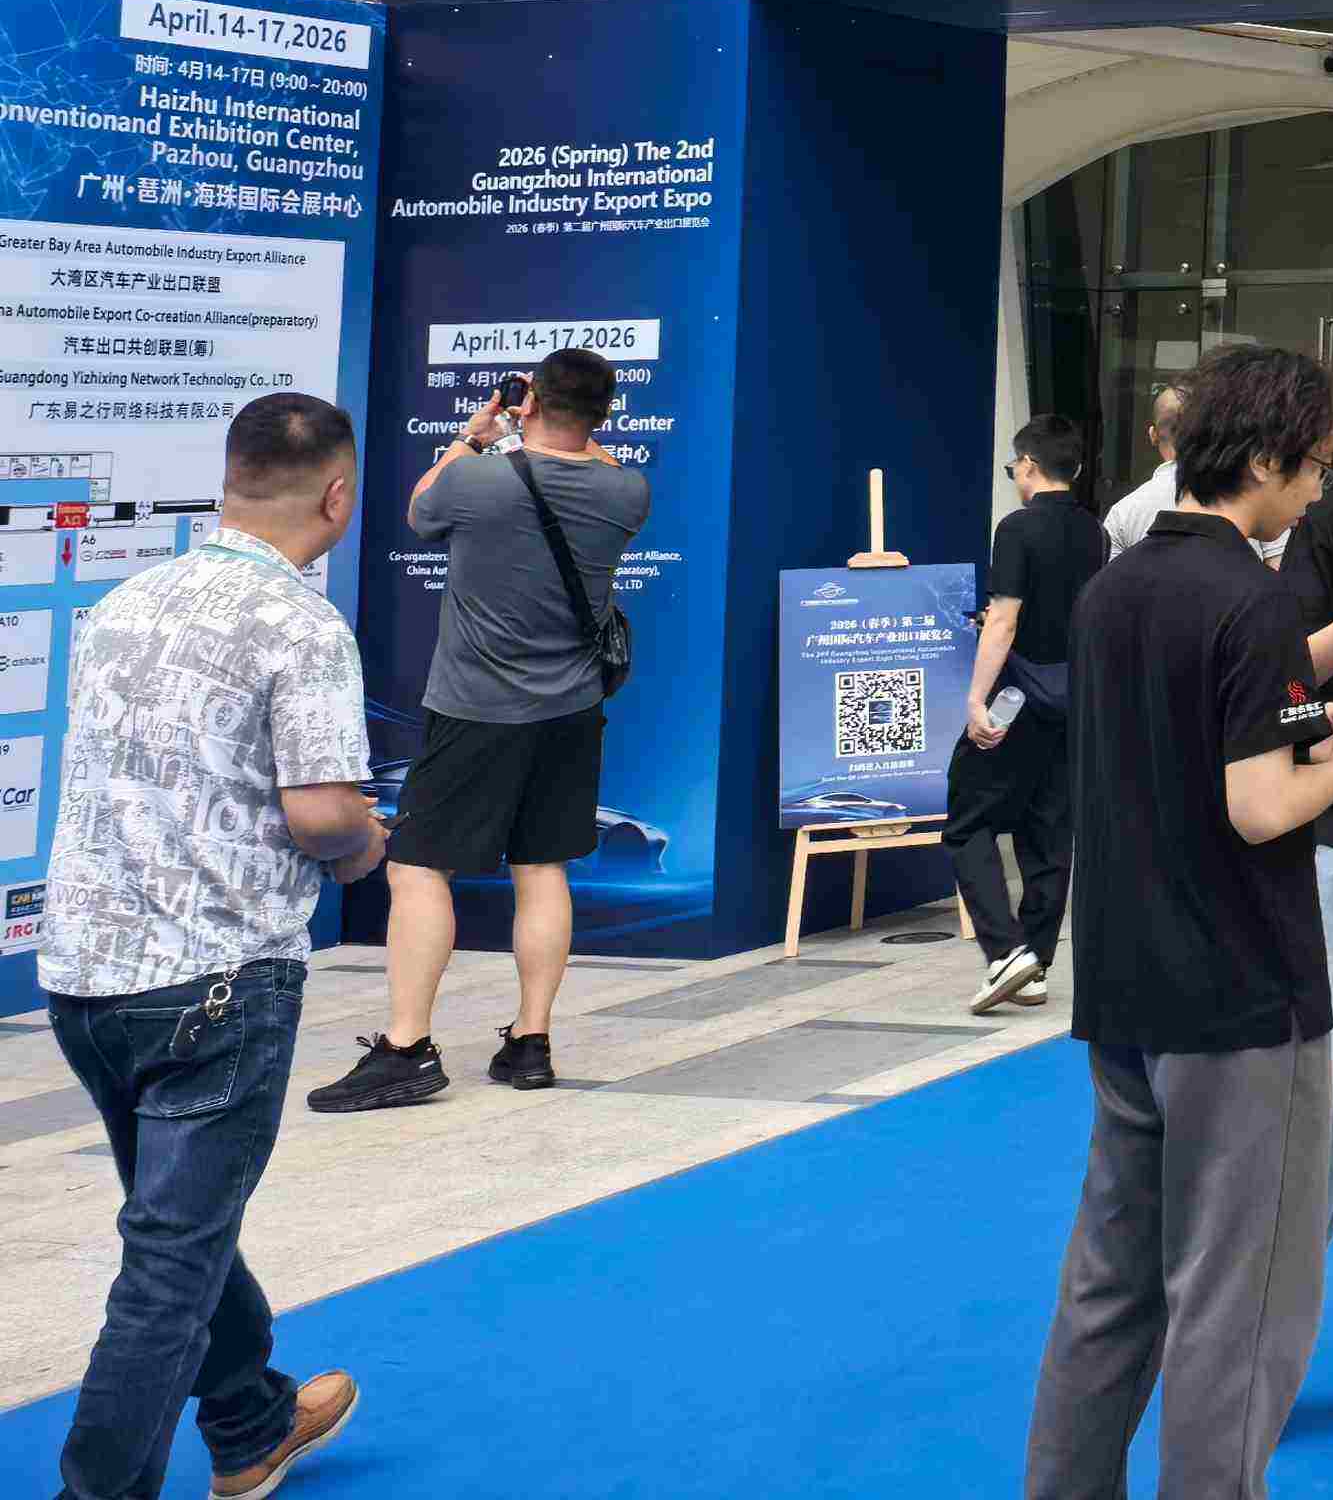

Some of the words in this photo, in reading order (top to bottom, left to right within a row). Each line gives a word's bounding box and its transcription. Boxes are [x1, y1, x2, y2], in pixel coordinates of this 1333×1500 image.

[148, 2, 347, 53] April.14-17,2026
[140, 85, 218, 116] Haizhu
[225, 96, 361, 131] International
[169, 115, 279, 148] Exhibition
[286, 128, 359, 159] Center,
[151, 140, 239, 173] Pazhou,
[247, 150, 364, 183] Guangzhou
[499, 146, 546, 167] 2026
[551, 142, 629, 169] (Spring)
[634, 141, 671, 161] The
[676, 138, 714, 159] 2nd
[472, 170, 581, 195] Guangzhou
[587, 163, 713, 188] International
[391, 196, 503, 217] Automobile
[508, 193, 589, 217] Industry
[594, 190, 658, 216] Export
[663, 189, 712, 212] Expo
[0, 235, 46, 251] Greater
[50, 237, 71, 254] Bay
[74, 239, 102, 254] Area
[105, 241, 174, 258] Automobile
[177, 246, 224, 264] Industry
[225, 248, 262, 266] Export
[264, 251, 306, 265] Alliance
[50, 269, 222, 294] 大湾区汽车产业出口联盟
[16, 304, 90, 320] Automobile
[93, 306, 132, 323] Export
[135, 308, 202, 324] Co-creation
[204, 311, 319, 329] Alliance(preparatory)
[72, 370, 127, 388] Yizhixing
[130, 372, 181, 387] Network
[182, 372, 248, 390] Technology
[272, 374, 293, 387] LTD
[617, 414, 675, 432] Center
[407, 565, 431, 576] China
